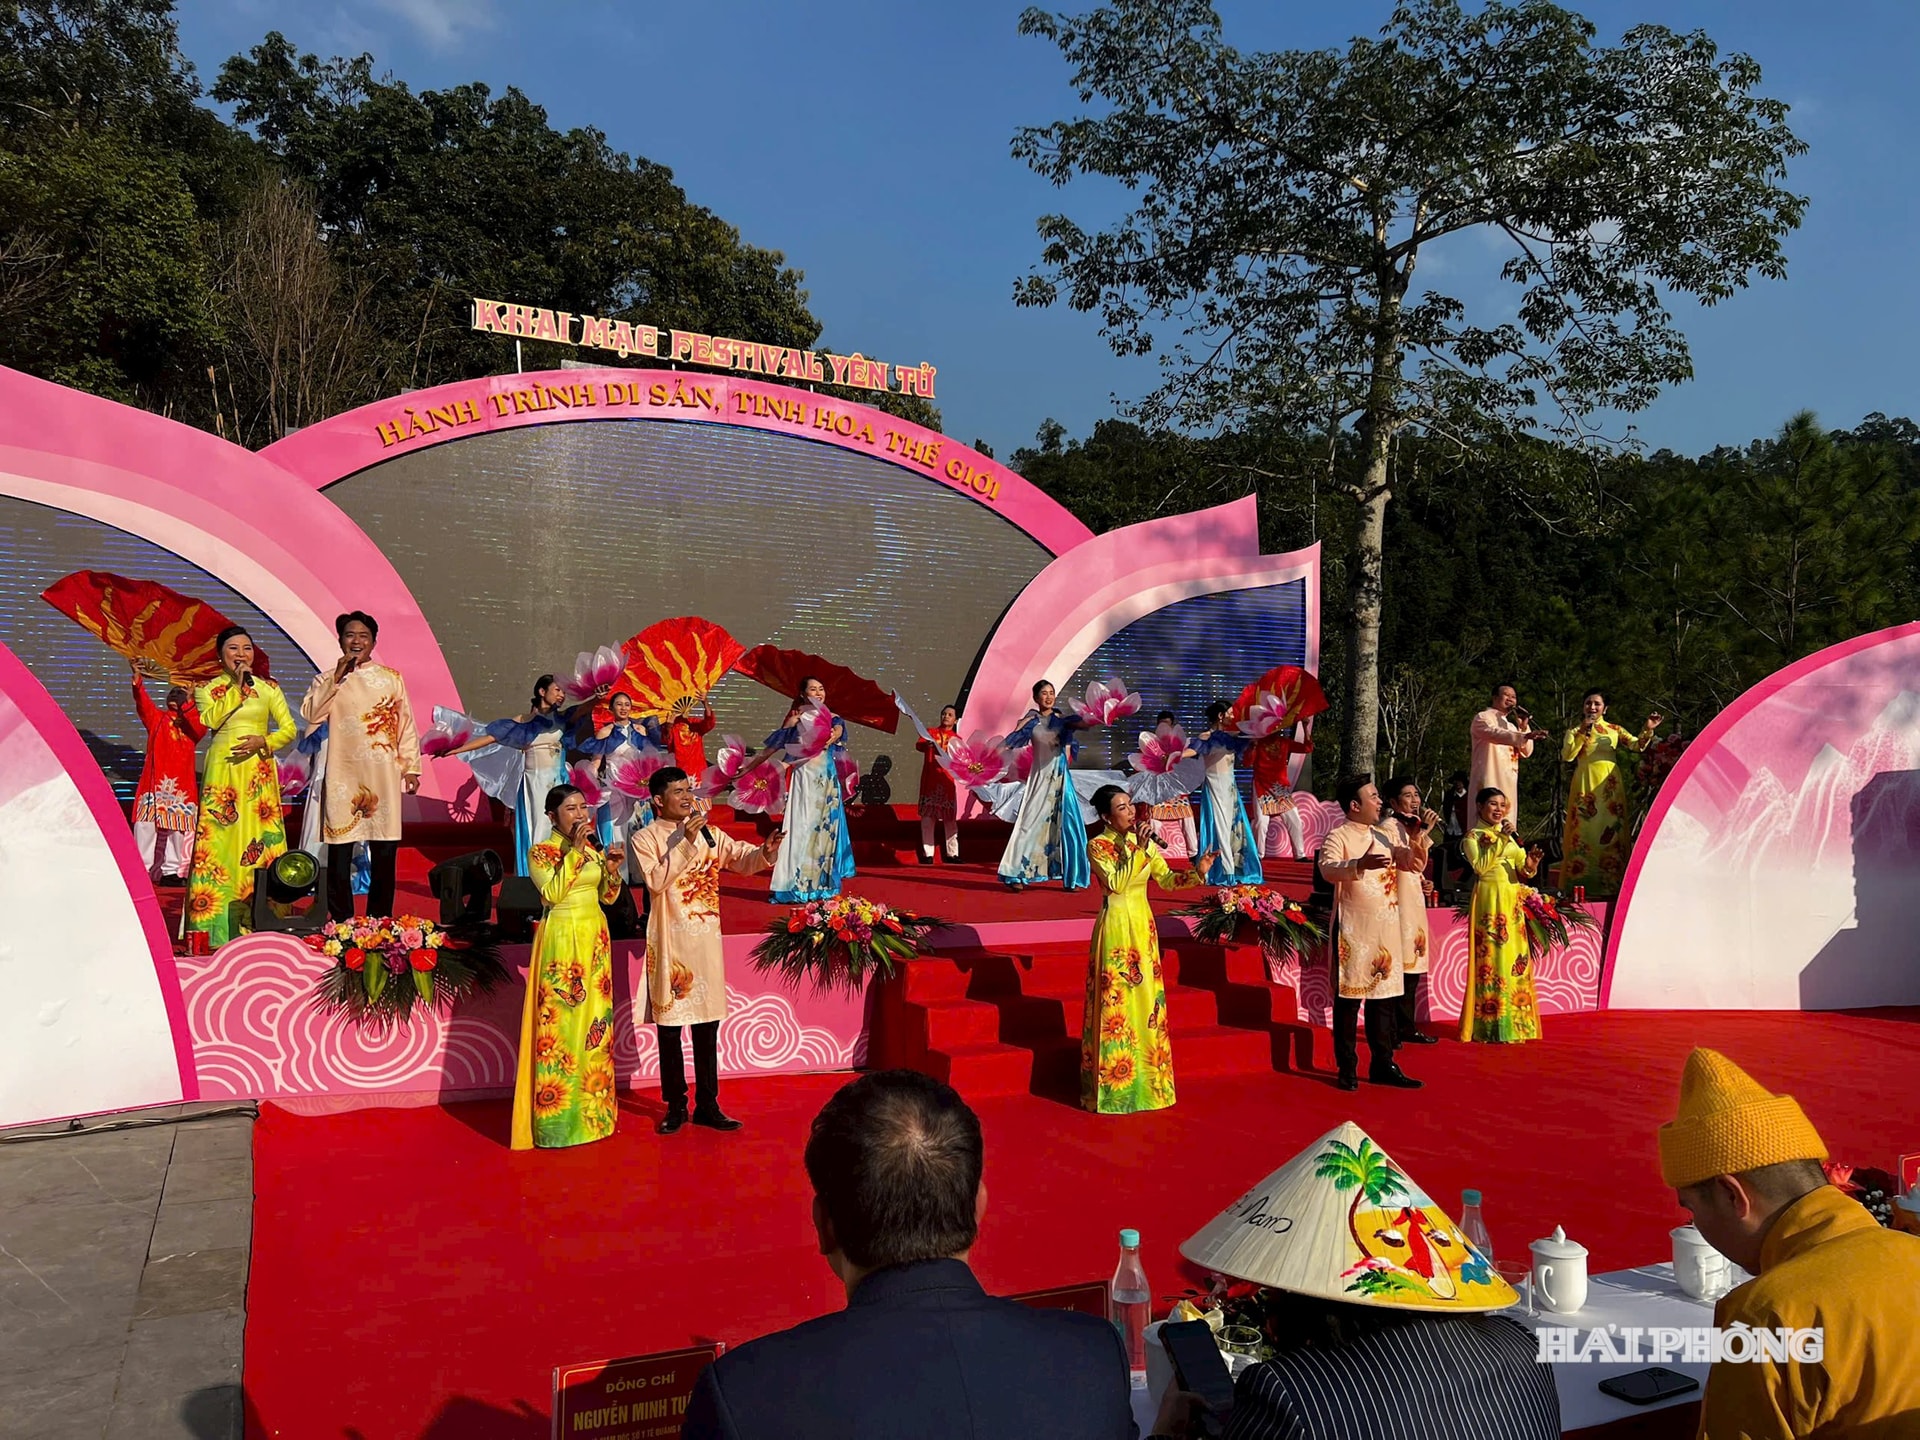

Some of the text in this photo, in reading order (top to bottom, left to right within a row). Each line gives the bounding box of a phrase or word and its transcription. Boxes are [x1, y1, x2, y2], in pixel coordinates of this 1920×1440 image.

[472, 298, 937, 399] KHAI MẠC FESTIVAL YÊN TỬ
[376, 378, 1001, 501] HÀNH TRÌNH DI SẢN, TINH HOA THẾ GIỚI
[651, 1371, 676, 1387] CHÍ
[573, 1399, 629, 1432] NGUYỄN
[632, 1398, 668, 1423] MINH
